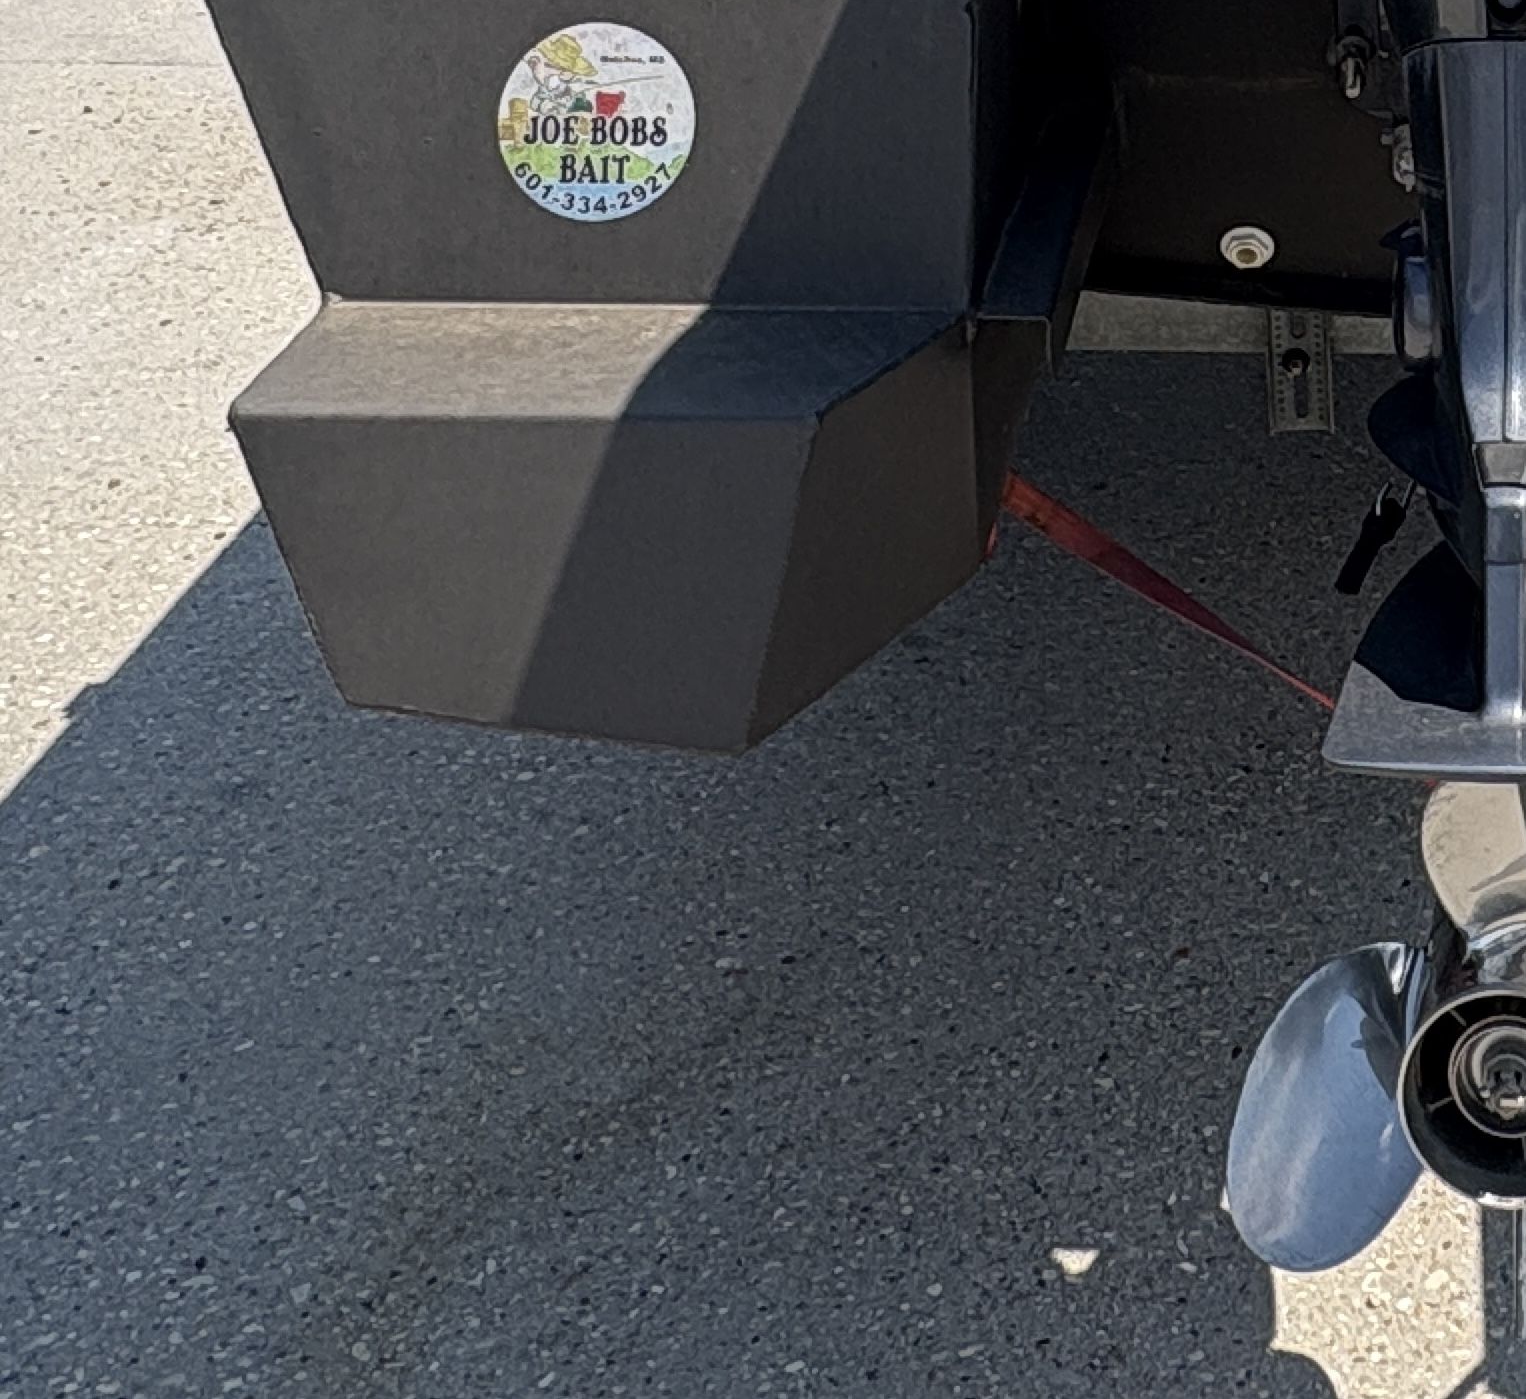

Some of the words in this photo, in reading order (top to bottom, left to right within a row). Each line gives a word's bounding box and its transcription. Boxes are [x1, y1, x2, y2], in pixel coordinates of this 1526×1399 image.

[523, 115, 580, 145] JOE
[590, 115, 668, 146] BOBS
[559, 154, 631, 184] BAIT
[514, 162, 673, 215] 601-334-2927
